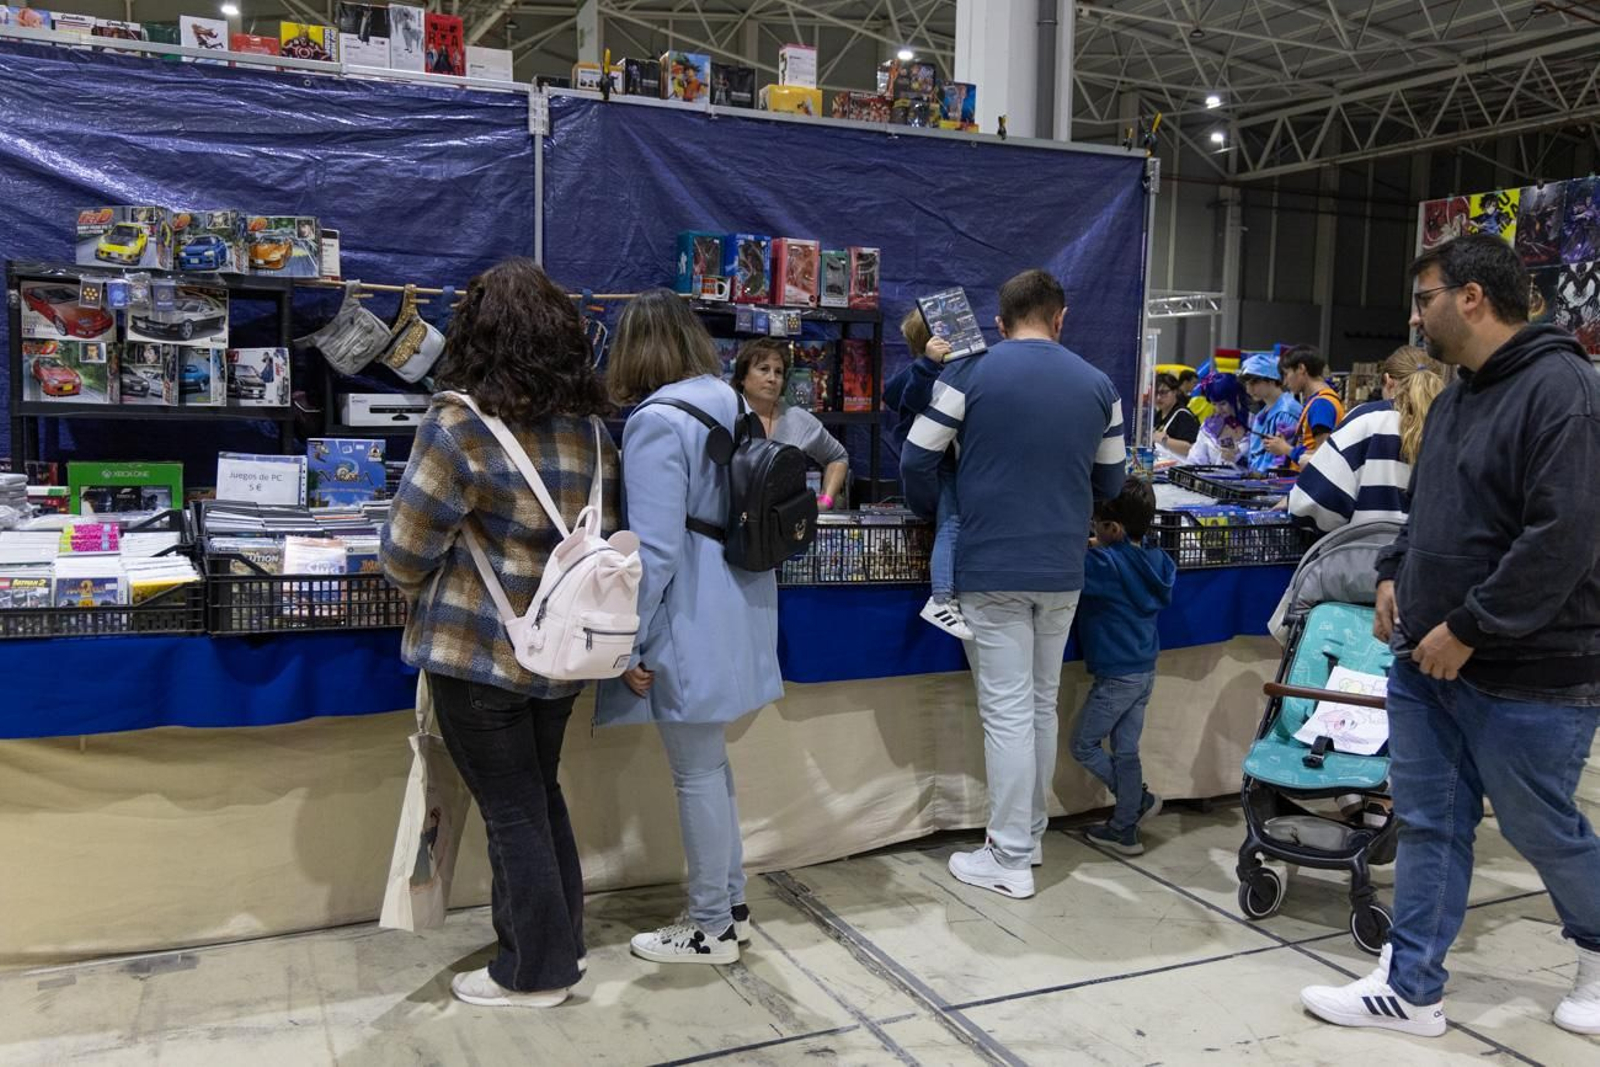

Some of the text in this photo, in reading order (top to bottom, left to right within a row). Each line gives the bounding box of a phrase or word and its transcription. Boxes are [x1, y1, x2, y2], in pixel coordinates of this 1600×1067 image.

[229, 472, 257, 481] Juegos
[271, 474, 283, 482] PC
[249, 484, 262, 492] 5 €
[39, 578, 46, 587] 2
